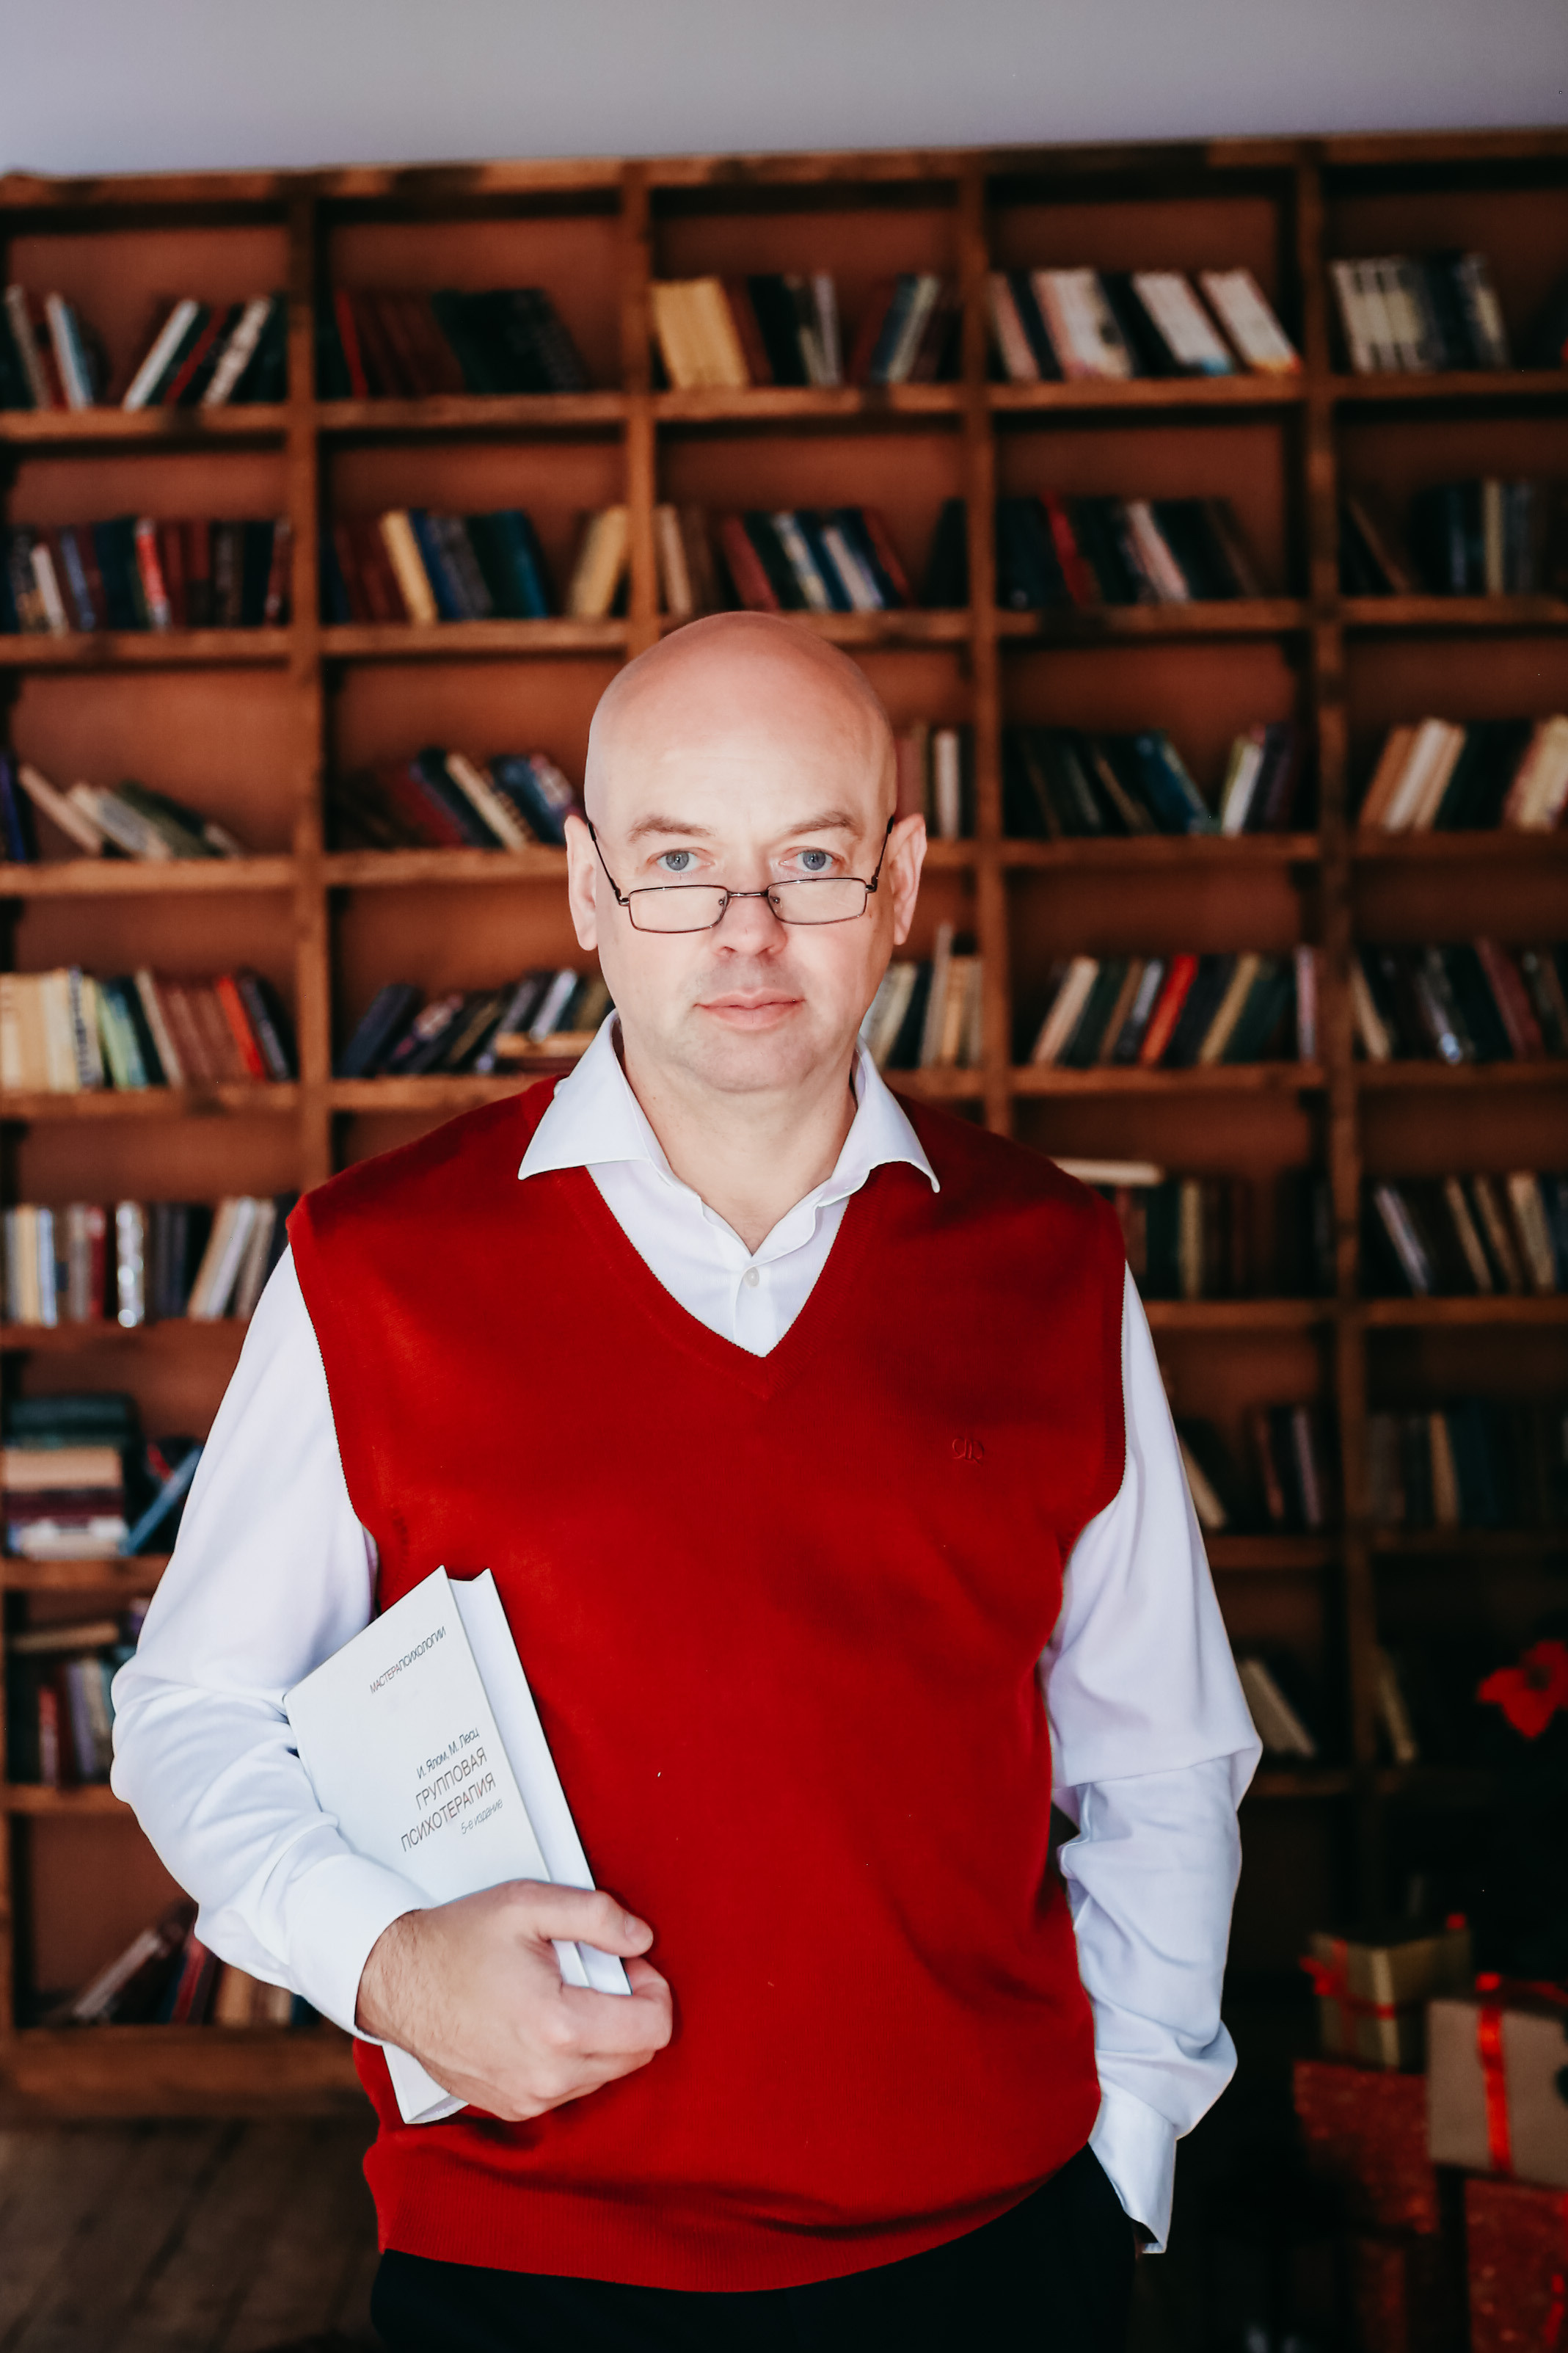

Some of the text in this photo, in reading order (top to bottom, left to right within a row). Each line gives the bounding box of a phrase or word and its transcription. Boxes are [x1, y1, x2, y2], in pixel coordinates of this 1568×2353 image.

[415, 1746, 488, 1811] ГРУППОВАЯ
[416, 1765, 427, 1779] И.
[426, 1751, 450, 1772] Ялом,
[448, 1740, 459, 1756] М.
[401, 1772, 497, 1852] ПСИХОТЕРАПИЯ
[461, 1798, 504, 1835] 5-е издание
